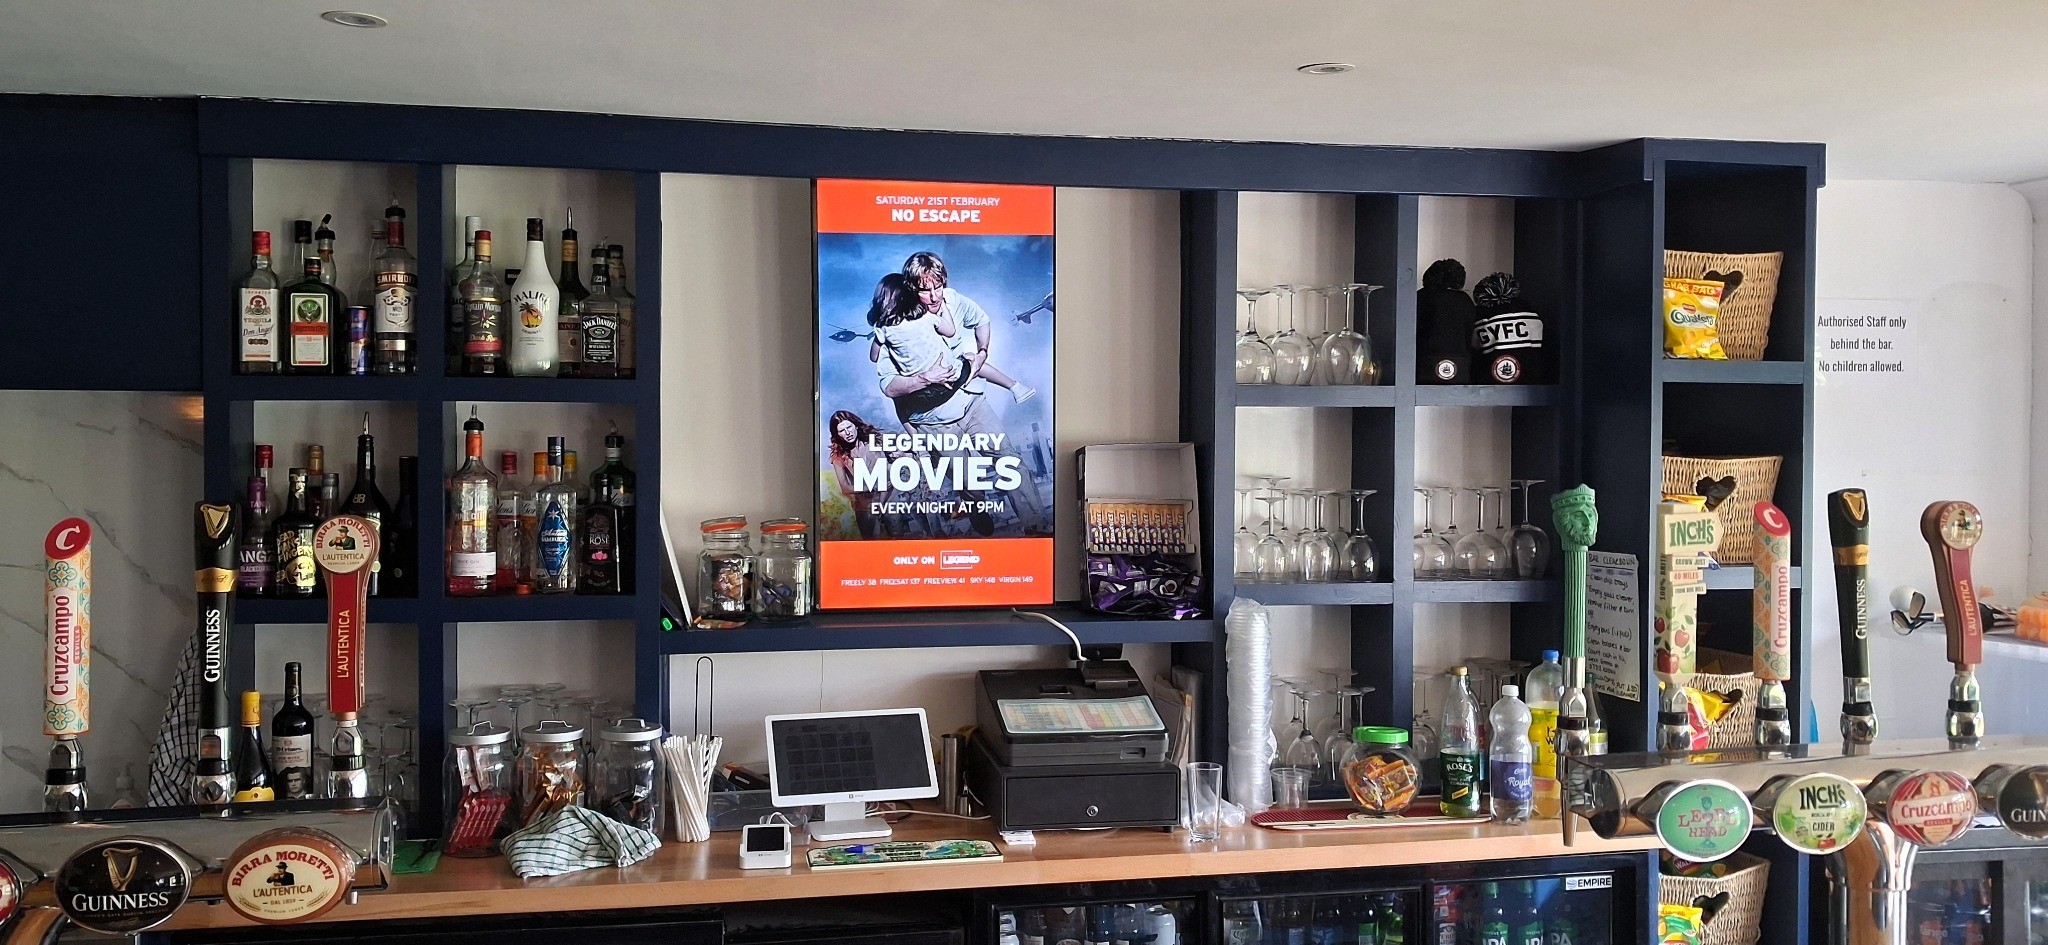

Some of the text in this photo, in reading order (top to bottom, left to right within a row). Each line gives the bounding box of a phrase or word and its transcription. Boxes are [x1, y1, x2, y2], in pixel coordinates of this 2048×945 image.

[875, 195, 1000, 207] SATURDAY 21ST FEBRUARY
[891, 209, 981, 223] NO ESCAPE
[1691, 284, 1716, 296] BAG
[583, 320, 597, 330] JACK
[1817, 315, 1907, 331] Authorised Staff only
[1477, 321, 1529, 345] GYFC
[1830, 338, 1894, 350] behind the bar.
[1818, 360, 1905, 373] No children allowed.
[868, 433, 1006, 452] LEGENDARY
[853, 456, 1022, 493] MOVIES
[870, 500, 1004, 515] EVERY NIGHT AT 9PM
[315, 518, 370, 549] BIRRA MORETTI
[1668, 518, 1715, 547] INCH'S
[589, 537, 610, 545] ROSE
[322, 553, 365, 561] L'AUTENTICA
[893, 556, 936, 566] ONLY ON
[942, 555, 981, 565] LEGEND
[841, 579, 866, 587] FREELY
[879, 578, 909, 586] FREESAT
[923, 577, 957, 585] FREEVIEW
[998, 576, 1021, 584] VIRGIN
[1683, 572, 1699, 580] MILES
[1774, 565, 1788, 650] Cruzcampo
[1855, 578, 1867, 640] GUINNESS
[1960, 579, 1978, 636] L'AUTENTICA
[50, 595, 73, 696] Cruzcampo
[204, 608, 221, 682] GUINNESS
[336, 608, 350, 679] L'AUTENTICA
[1446, 762, 1474, 773] ROSE'S
[1799, 784, 1847, 810] INCH'S
[1901, 800, 1972, 819] Cruzcampo
[1689, 826, 1727, 838] HEAD
[1812, 821, 1835, 832] CIDER
[231, 850, 335, 887] BIRRA MORETTI
[1577, 877, 1612, 888] EMPIRE
[252, 884, 313, 898] L'AUTENTICA
[72, 891, 169, 912] GUINNESS
